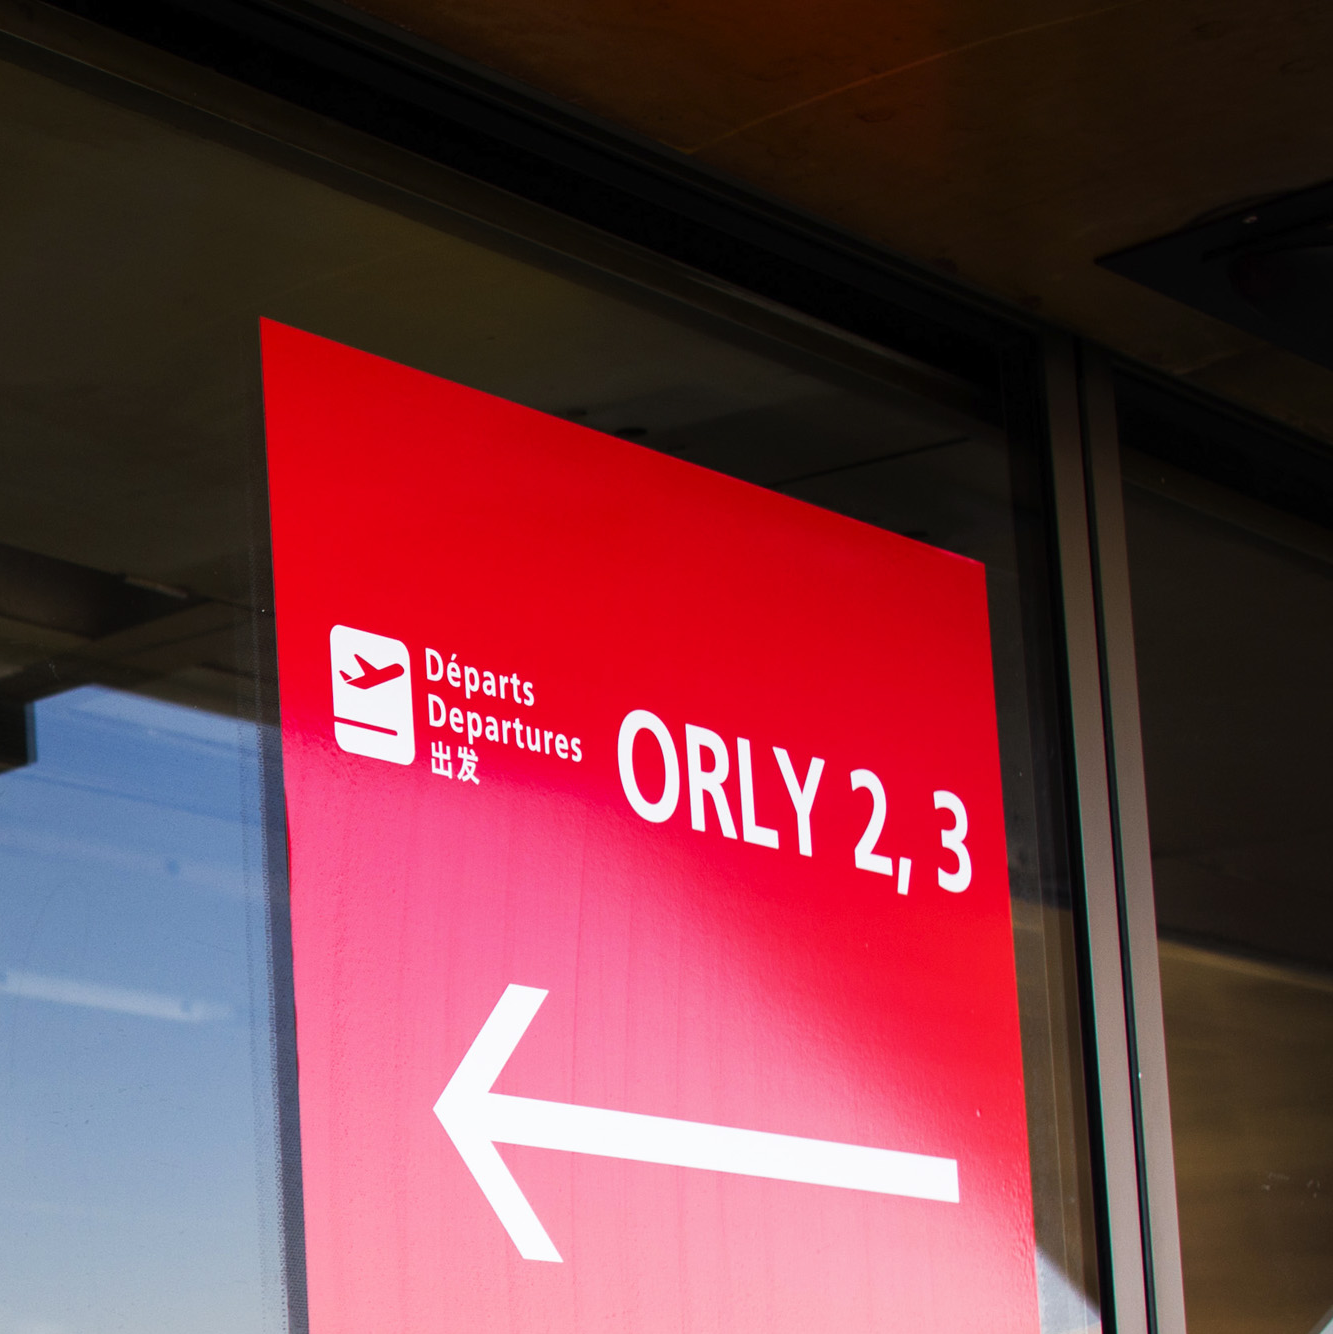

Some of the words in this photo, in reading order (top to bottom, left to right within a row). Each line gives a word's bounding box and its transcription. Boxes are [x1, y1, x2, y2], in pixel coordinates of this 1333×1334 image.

[425, 647, 535, 707] Départs
[427, 693, 583, 763] Departures
[431, 740, 481, 785] 出发
[617, 709, 825, 857] ORLY
[850, 768, 912, 896] 2,
[933, 790, 972, 893] 3
